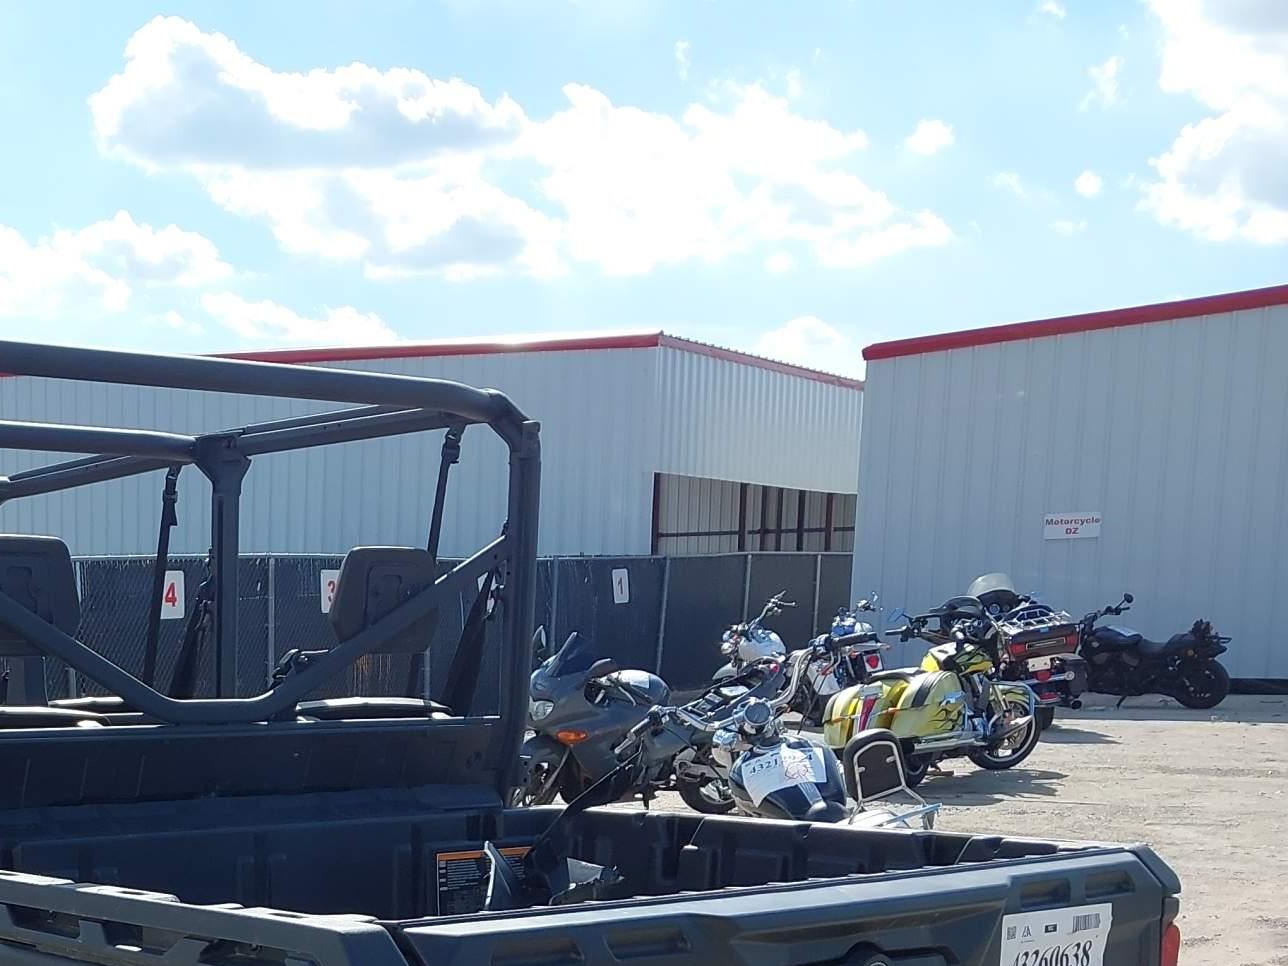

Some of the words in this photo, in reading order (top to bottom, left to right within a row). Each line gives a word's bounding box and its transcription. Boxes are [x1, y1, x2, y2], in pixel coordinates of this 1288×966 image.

[1046, 516, 1101, 526] Motorcycle
[165, 582, 177, 607] 4
[618, 576, 623, 595] 1
